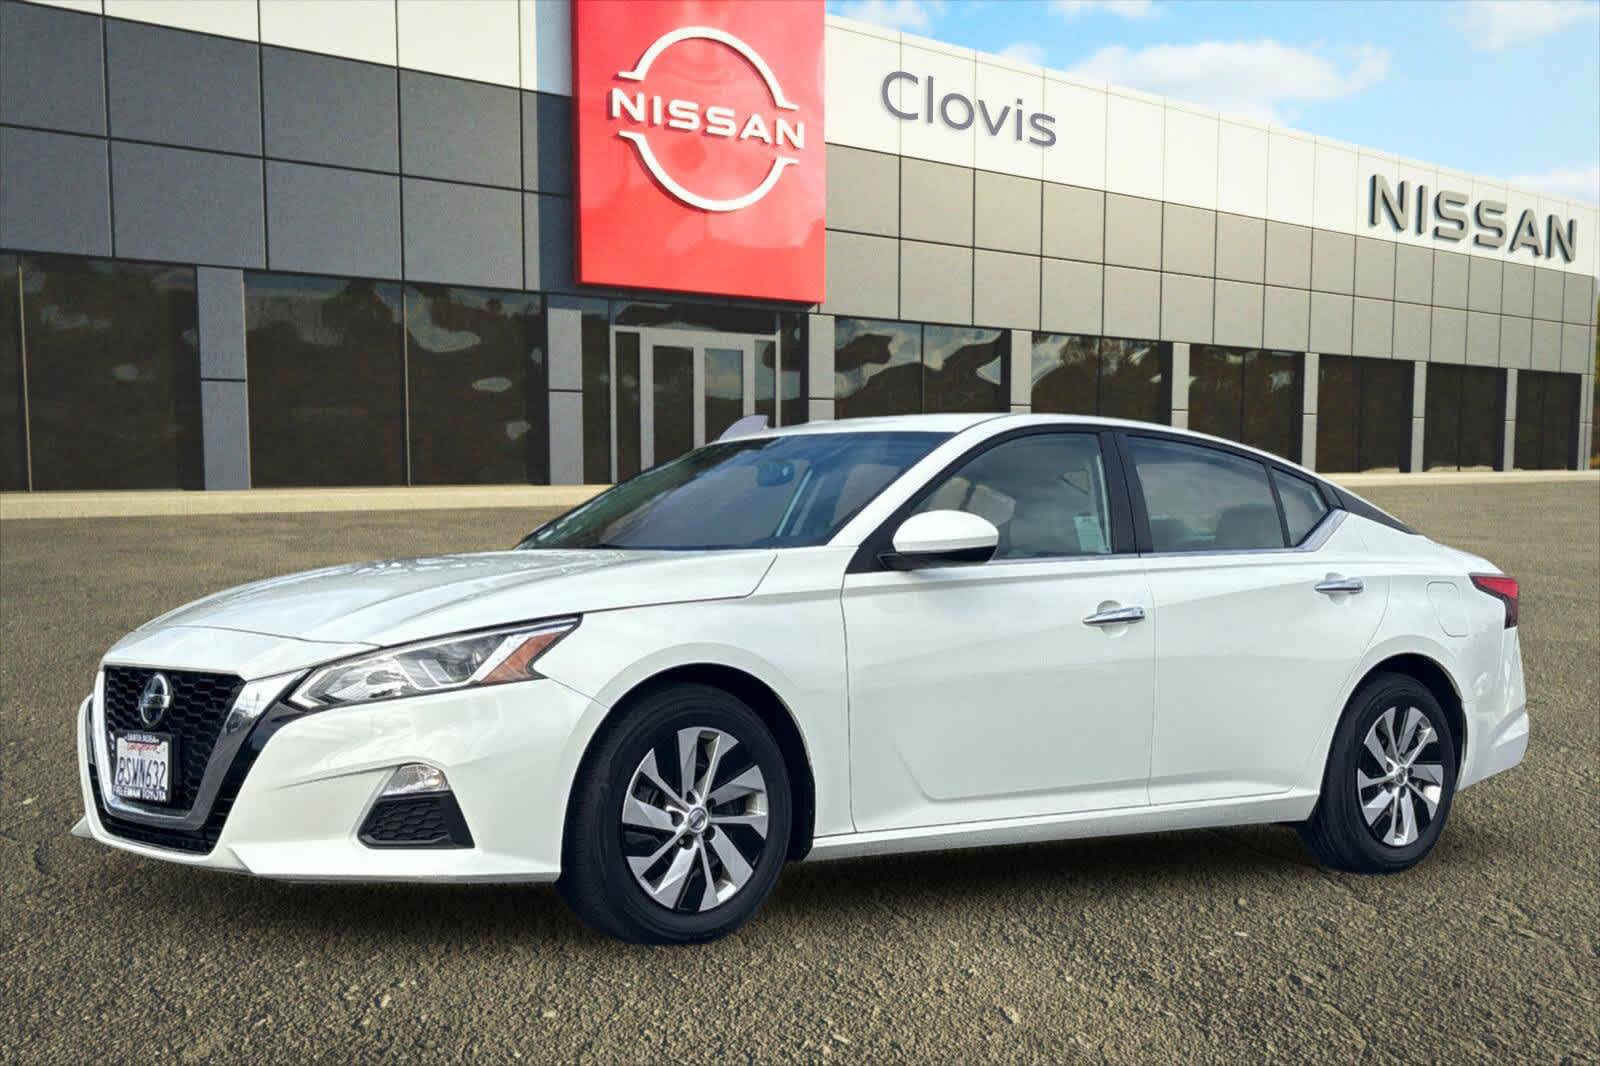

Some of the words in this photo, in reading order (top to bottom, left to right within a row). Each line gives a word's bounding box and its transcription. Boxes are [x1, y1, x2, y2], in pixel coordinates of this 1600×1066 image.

[609, 87, 805, 149] NISSAN
[881, 71, 1057, 147] Clovis
[1369, 174, 1578, 262] NISSAN
